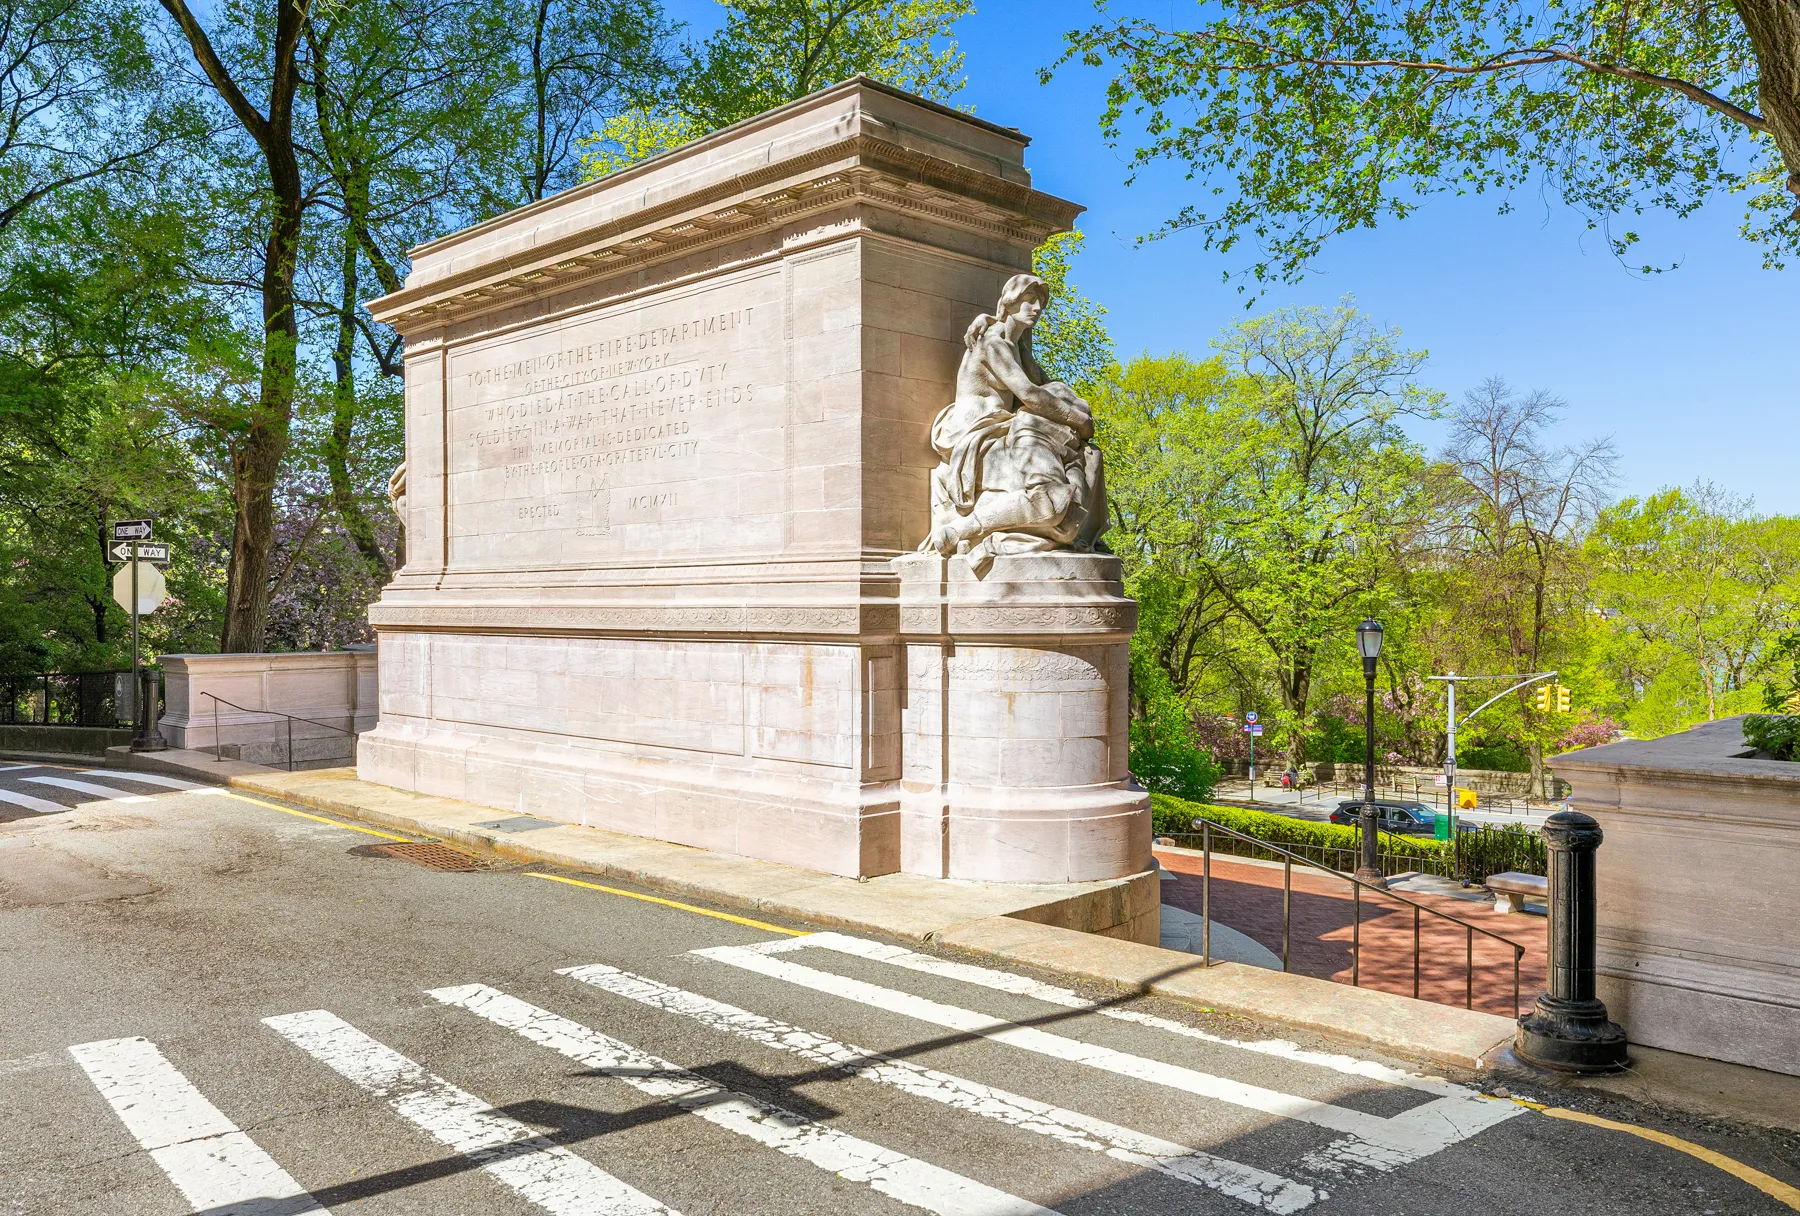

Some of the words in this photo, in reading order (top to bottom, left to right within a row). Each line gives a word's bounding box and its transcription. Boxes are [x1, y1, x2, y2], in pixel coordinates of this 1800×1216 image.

[468, 372, 483, 387] TO
[486, 366, 508, 384] THE
[513, 358, 541, 378] MEN
[546, 352, 563, 370] OF
[567, 346, 593, 366] THE
[599, 337, 631, 358] FIRE
[639, 307, 753, 350] DEPARTMENT
[525, 381, 538, 394] OF
[541, 376, 559, 388] THE
[563, 370, 588, 387] CITY
[591, 366, 605, 381] OF
[609, 360, 634, 377] NEW
[637, 352, 669, 371] YORK
[469, 423, 528, 447] SOLDIERS
[534, 420, 548, 436] IN
[554, 419, 559, 434] A
[566, 412, 593, 429] WAR
[602, 404, 636, 425] THAT
[645, 394, 696, 418] NEVER
[706, 383, 753, 408] ENDS
[485, 405, 514, 421] WHO
[520, 398, 553, 418] DIED
[558, 393, 573, 410] AT
[578, 388, 605, 407] THE
[610, 379, 650, 401] CALL
[656, 373, 675, 392] OF
[505, 465, 515, 479] BY
[518, 463, 535, 477] THE
[538, 457, 577, 475] PEOPLE
[580, 455, 593, 469] OF
[596, 454, 602, 467] A
[668, 440, 698, 457] CITY
[513, 444, 535, 459] THIS
[539, 434, 598, 456] MEMORIAL
[602, 432, 612, 446] IS
[617, 421, 690, 444] DEDICATED
[118, 527, 128, 535] ONE
[134, 526, 146, 534] WAY
[518, 504, 560, 519] ERECTED
